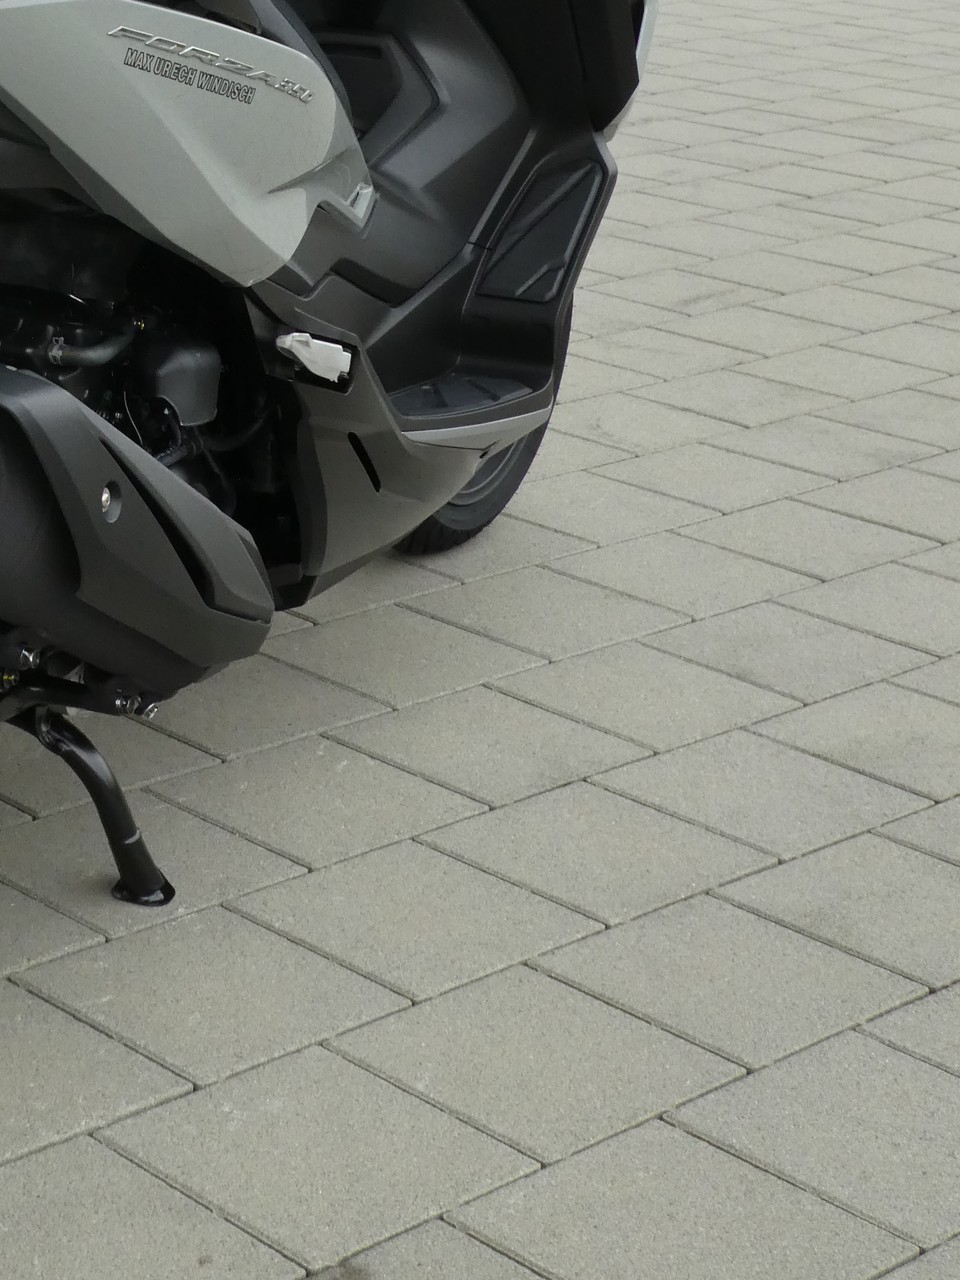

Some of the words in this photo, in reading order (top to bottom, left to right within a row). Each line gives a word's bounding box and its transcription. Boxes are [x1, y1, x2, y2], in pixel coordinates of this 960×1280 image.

[107, 26, 277, 87] FORZA
[123, 47, 155, 73] MAX
[153, 56, 197, 87] URECH
[196, 70, 257, 104] WINDISCH
